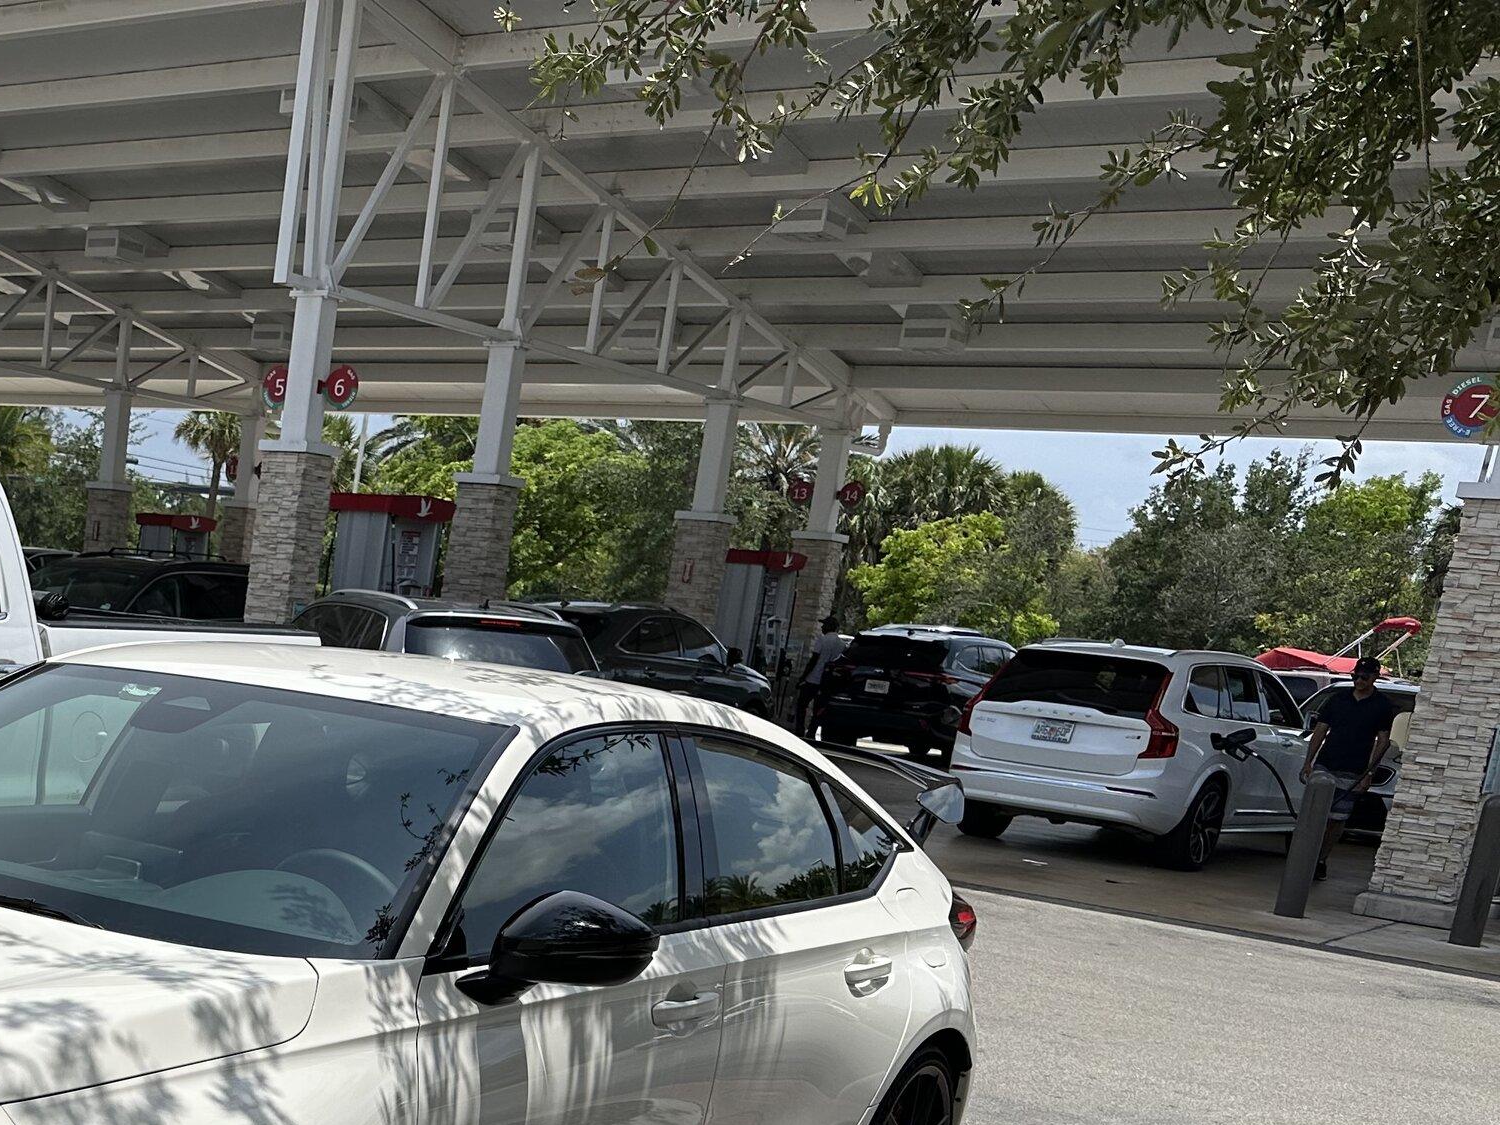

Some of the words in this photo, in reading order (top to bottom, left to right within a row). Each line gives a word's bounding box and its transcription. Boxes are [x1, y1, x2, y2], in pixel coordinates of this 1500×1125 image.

[346, 368, 356, 380] GAS
[274, 378, 285, 396] 5
[334, 378, 345, 397] 6
[1451, 376, 1482, 395] DIESEL
[1443, 398, 1453, 415] GAS
[1468, 393, 1490, 419] 7
[792, 488, 808, 500] 13
[844, 490, 858, 502] 14
